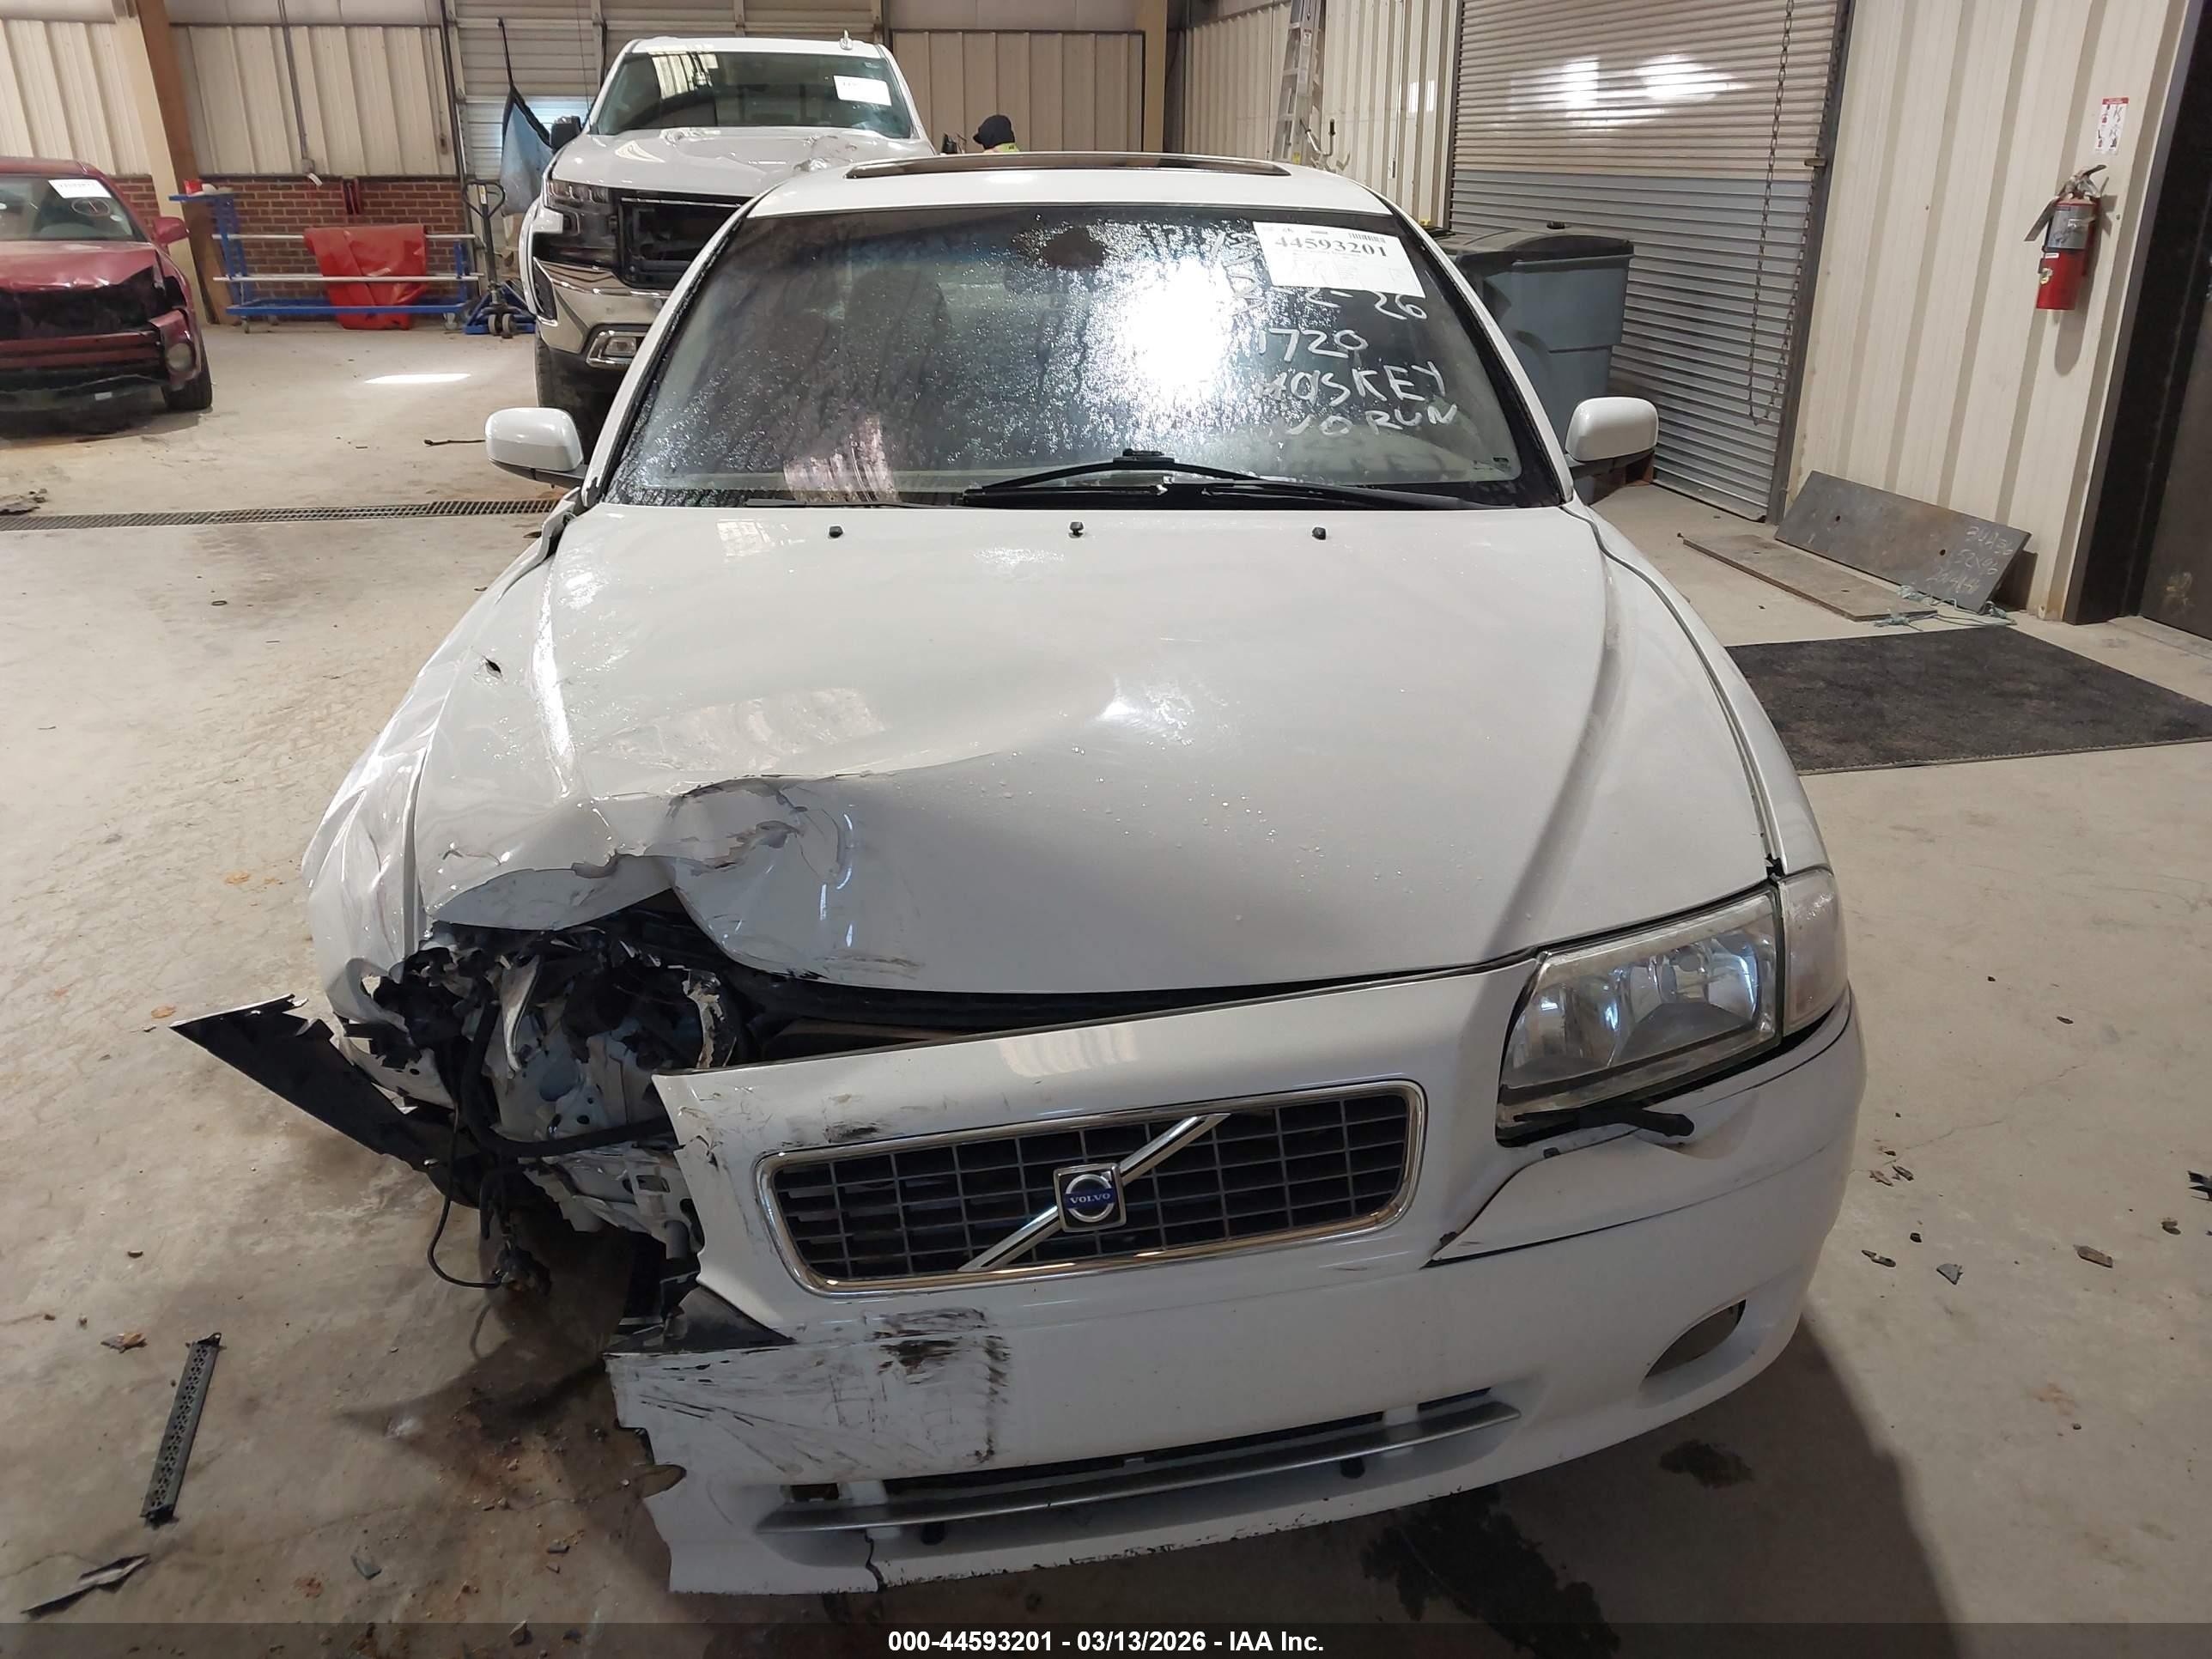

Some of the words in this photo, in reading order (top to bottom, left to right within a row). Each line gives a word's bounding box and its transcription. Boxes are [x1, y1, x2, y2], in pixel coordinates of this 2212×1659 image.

[1275, 236, 1388, 257] 44593201
[1259, 328, 1369, 362] 1720
[1352, 361, 1446, 402] KEY
[1365, 403, 1458, 435] RUN
[1070, 1193, 1111, 1204] VOLVO
